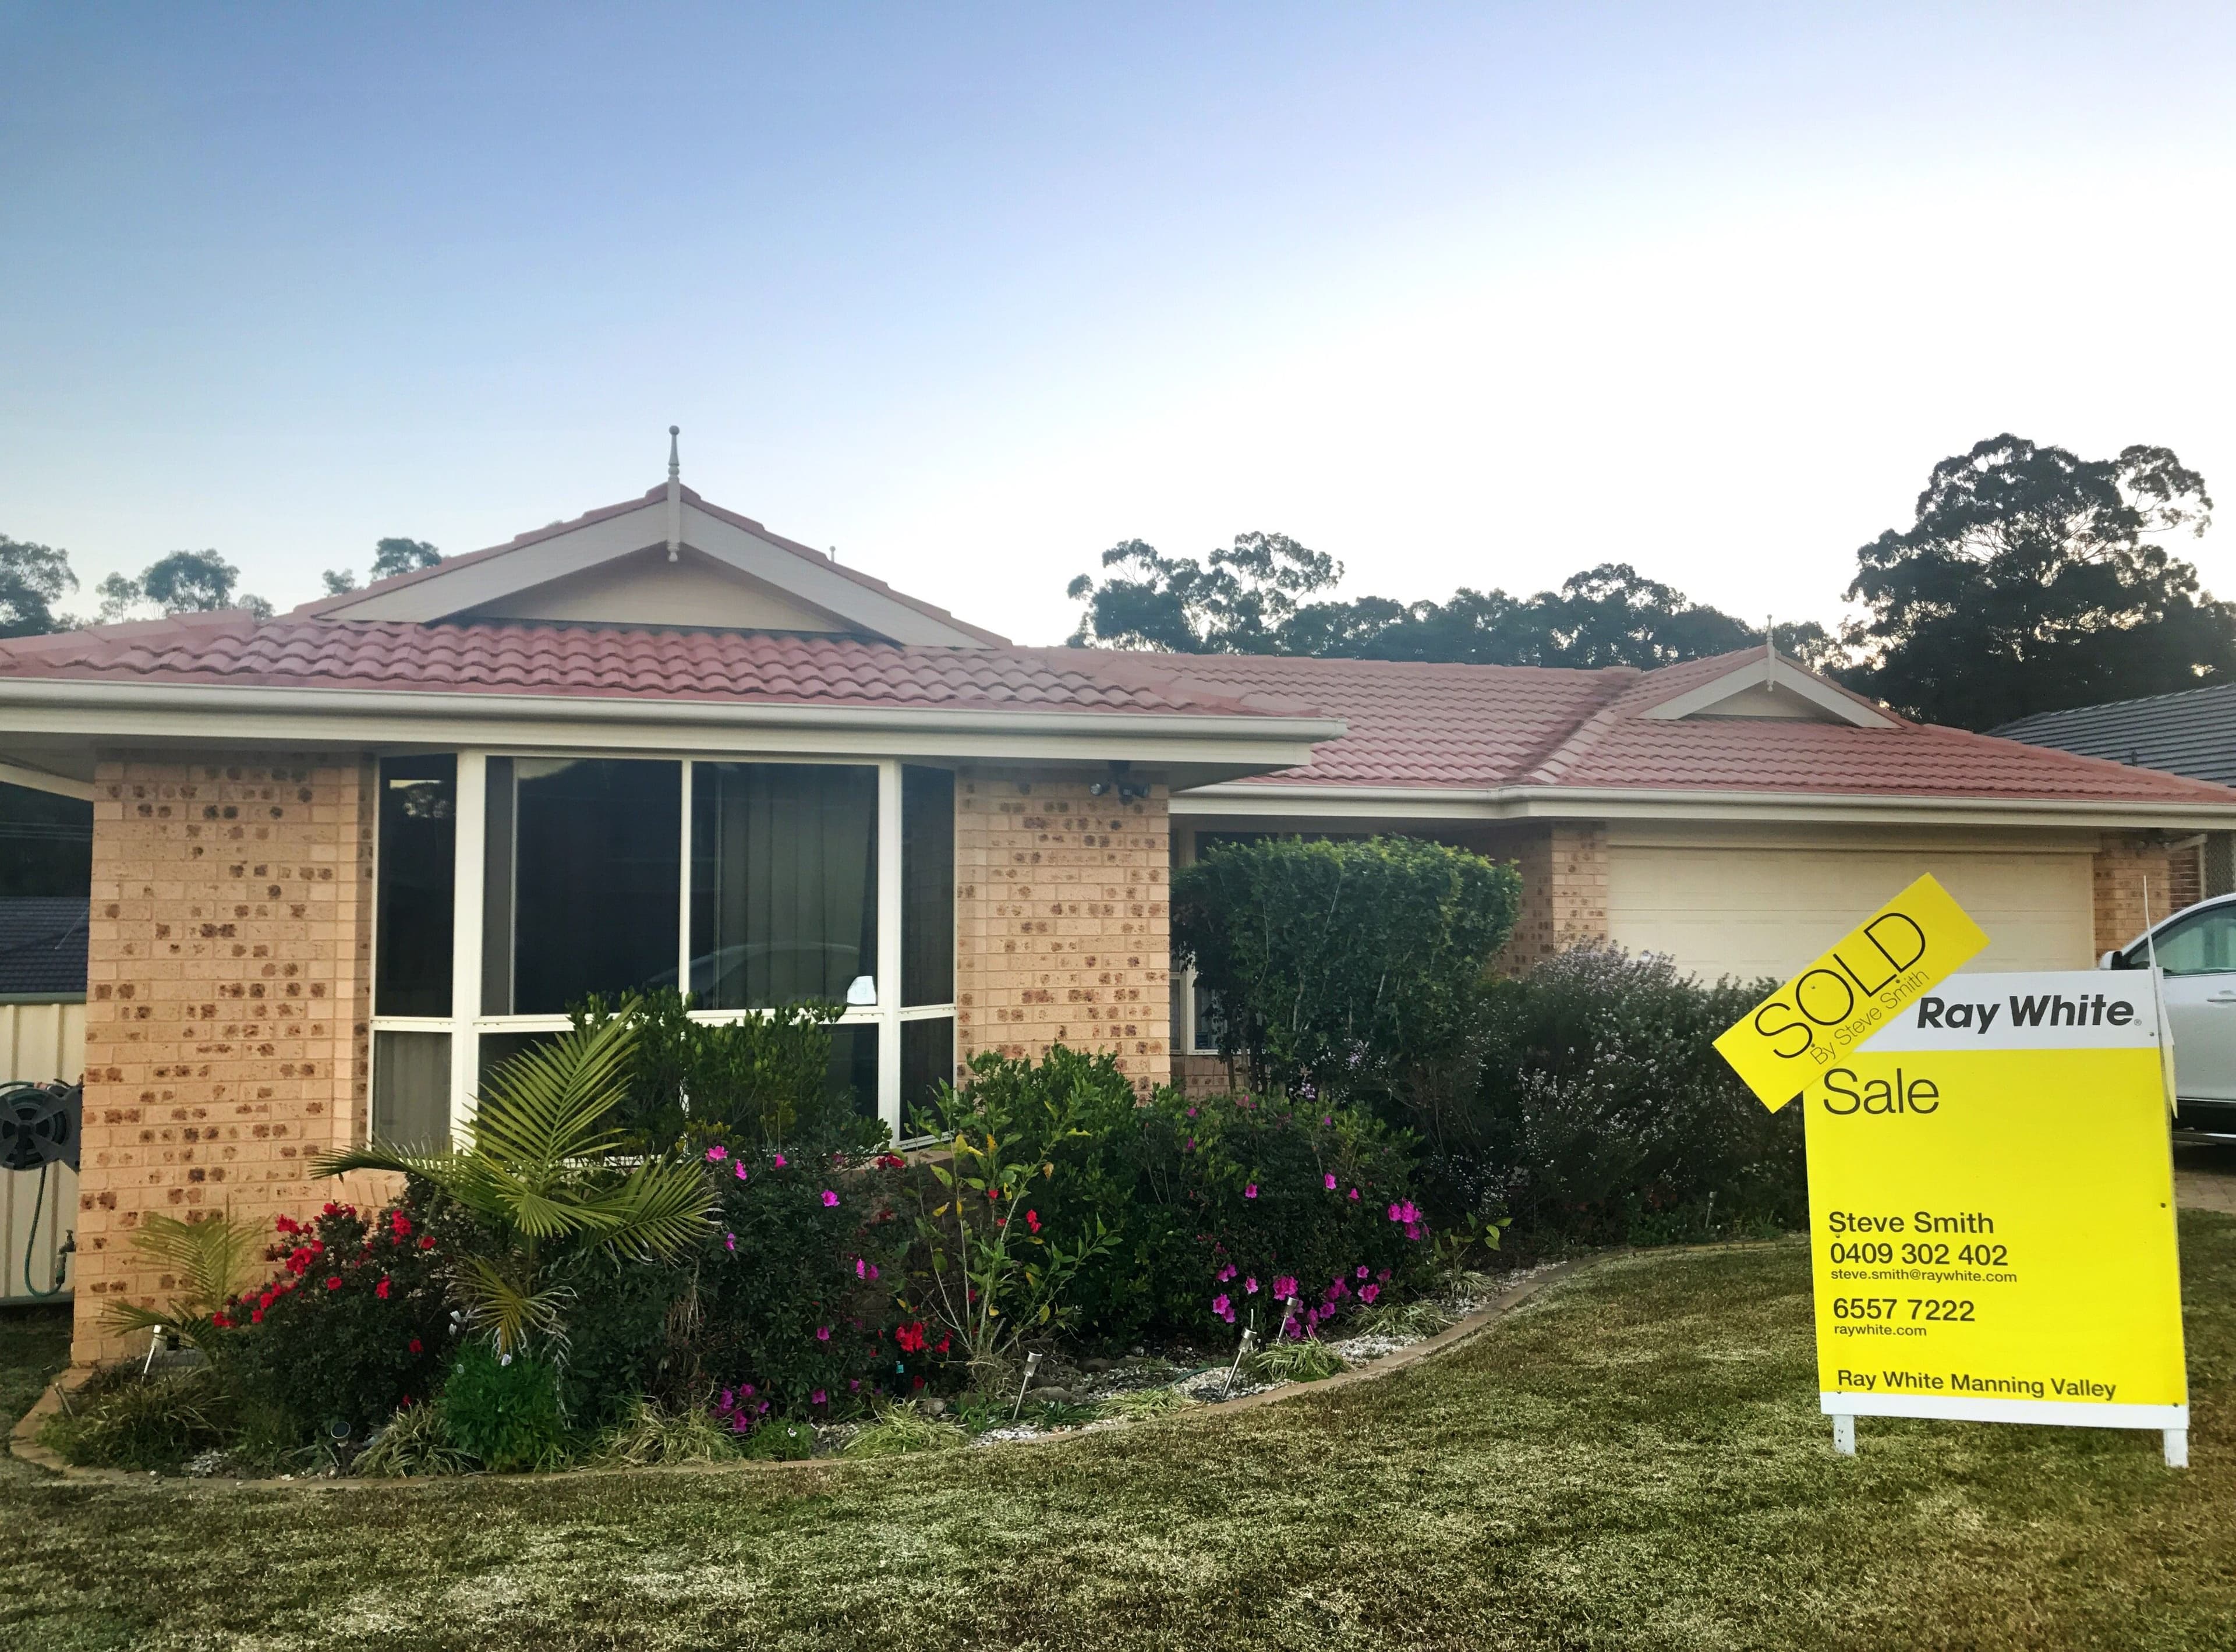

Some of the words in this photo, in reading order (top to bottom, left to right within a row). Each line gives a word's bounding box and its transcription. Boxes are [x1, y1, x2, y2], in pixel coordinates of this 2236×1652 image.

[1755, 912, 1926, 1059] SOLD
[1810, 1041, 1836, 1065] By
[1835, 1006, 1883, 1046] Steve
[1880, 969, 1929, 1011] Smith
[1917, 996, 2000, 1034] Ray
[2010, 993, 2134, 1027] White
[1823, 1068, 1939, 1115] Sale
[1829, 1211, 1905, 1233] Steve
[1914, 1212, 1994, 1234] Smith
[1830, 1243, 1893, 1264] 0409
[1901, 1244, 1950, 1265] 302
[1958, 1244, 2008, 1266] 402
[1831, 1269, 2018, 1283] steve.smith@raywhite.com
[1833, 1298, 1897, 1319] 6557
[1908, 1299, 1975, 1321] 7222
[1834, 1324, 1927, 1337] raywhite.com
[1838, 1370, 1876, 1390] Ray
[1883, 1371, 1944, 1390] White
[1951, 1374, 2044, 1397] Manning
[2051, 1378, 2116, 1400] Valley
